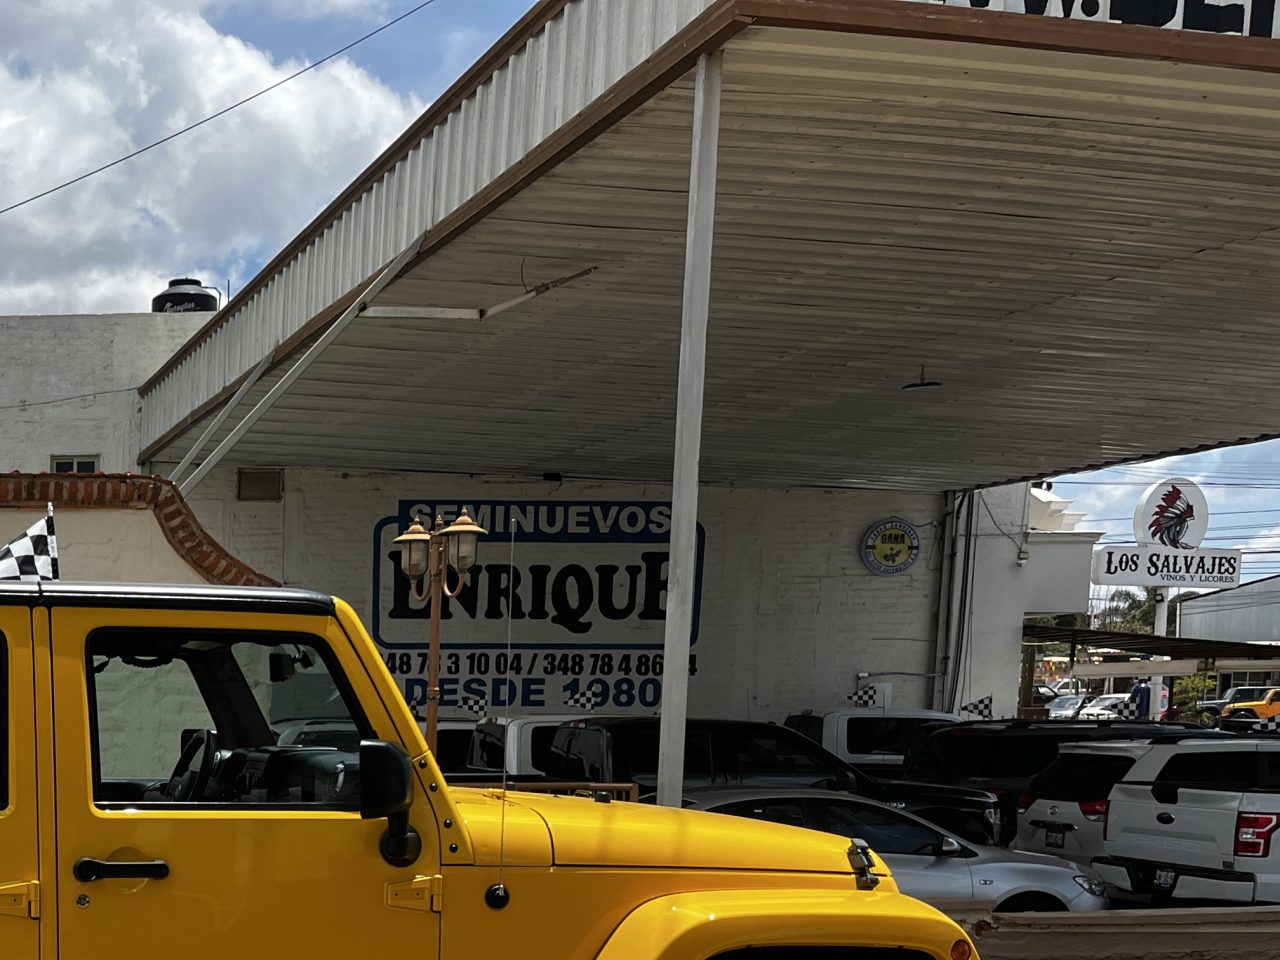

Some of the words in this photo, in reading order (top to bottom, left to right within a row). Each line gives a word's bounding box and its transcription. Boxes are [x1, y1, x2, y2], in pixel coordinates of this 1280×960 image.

[408, 503, 671, 534] SEMINUEVOS
[1105, 551, 1140, 575] LOS
[1147, 552, 1237, 577] SALVAJES
[388, 551, 669, 633] ENRIQUE
[1160, 574, 1186, 582] VINOS
[1190, 574, 1196, 582] Y
[1199, 575, 1235, 583] LICORES
[381, 653, 412, 675] 48
[447, 653, 460, 675] 3
[466, 653, 490, 675] 10
[495, 653, 523, 675] 04
[543, 653, 584, 676] 348
[589, 654, 613, 676] 78
[618, 654, 632, 676] 4
[405, 677, 545, 707] DESDE
[563, 677, 662, 708] 1980
